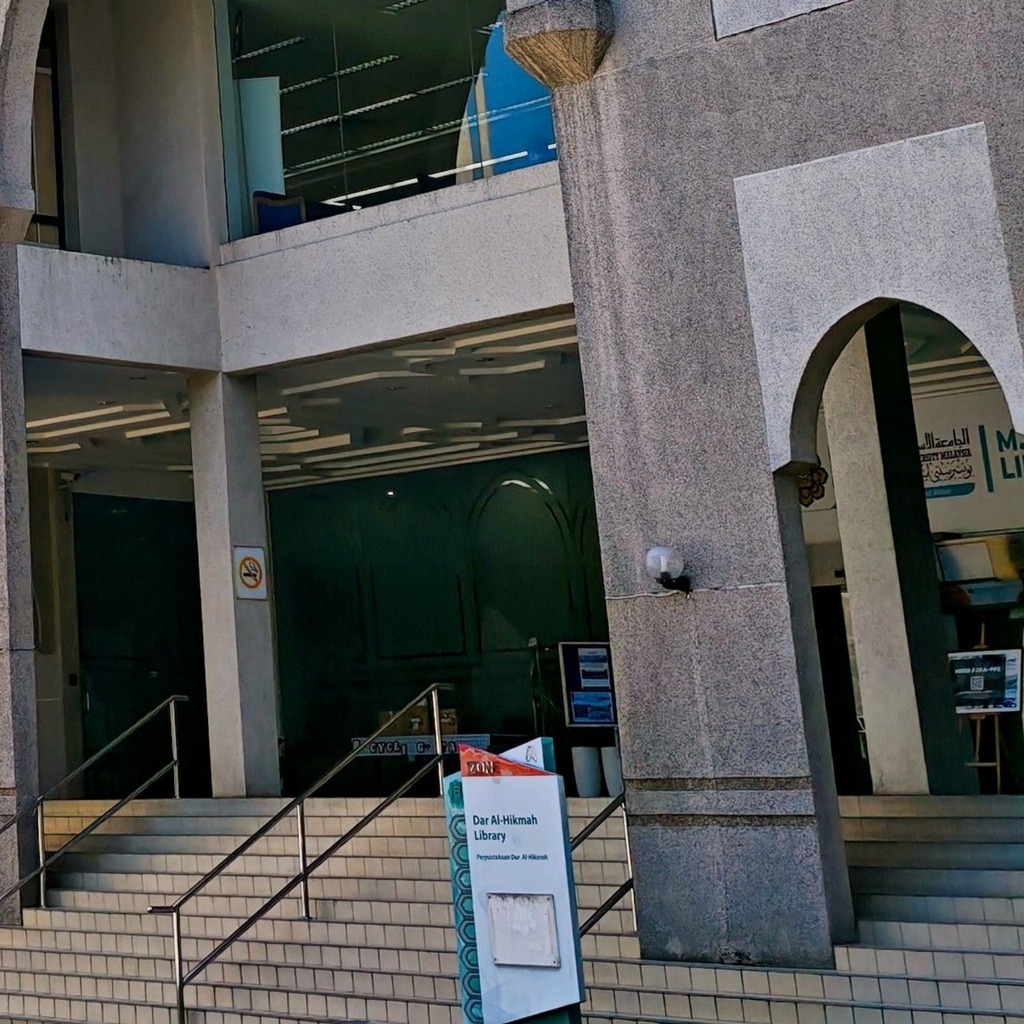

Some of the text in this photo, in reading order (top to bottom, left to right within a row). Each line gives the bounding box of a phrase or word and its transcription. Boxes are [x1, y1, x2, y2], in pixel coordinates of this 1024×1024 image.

[473, 814, 538, 825] Dar Al-Hikmah
[474, 830, 506, 843] Library
